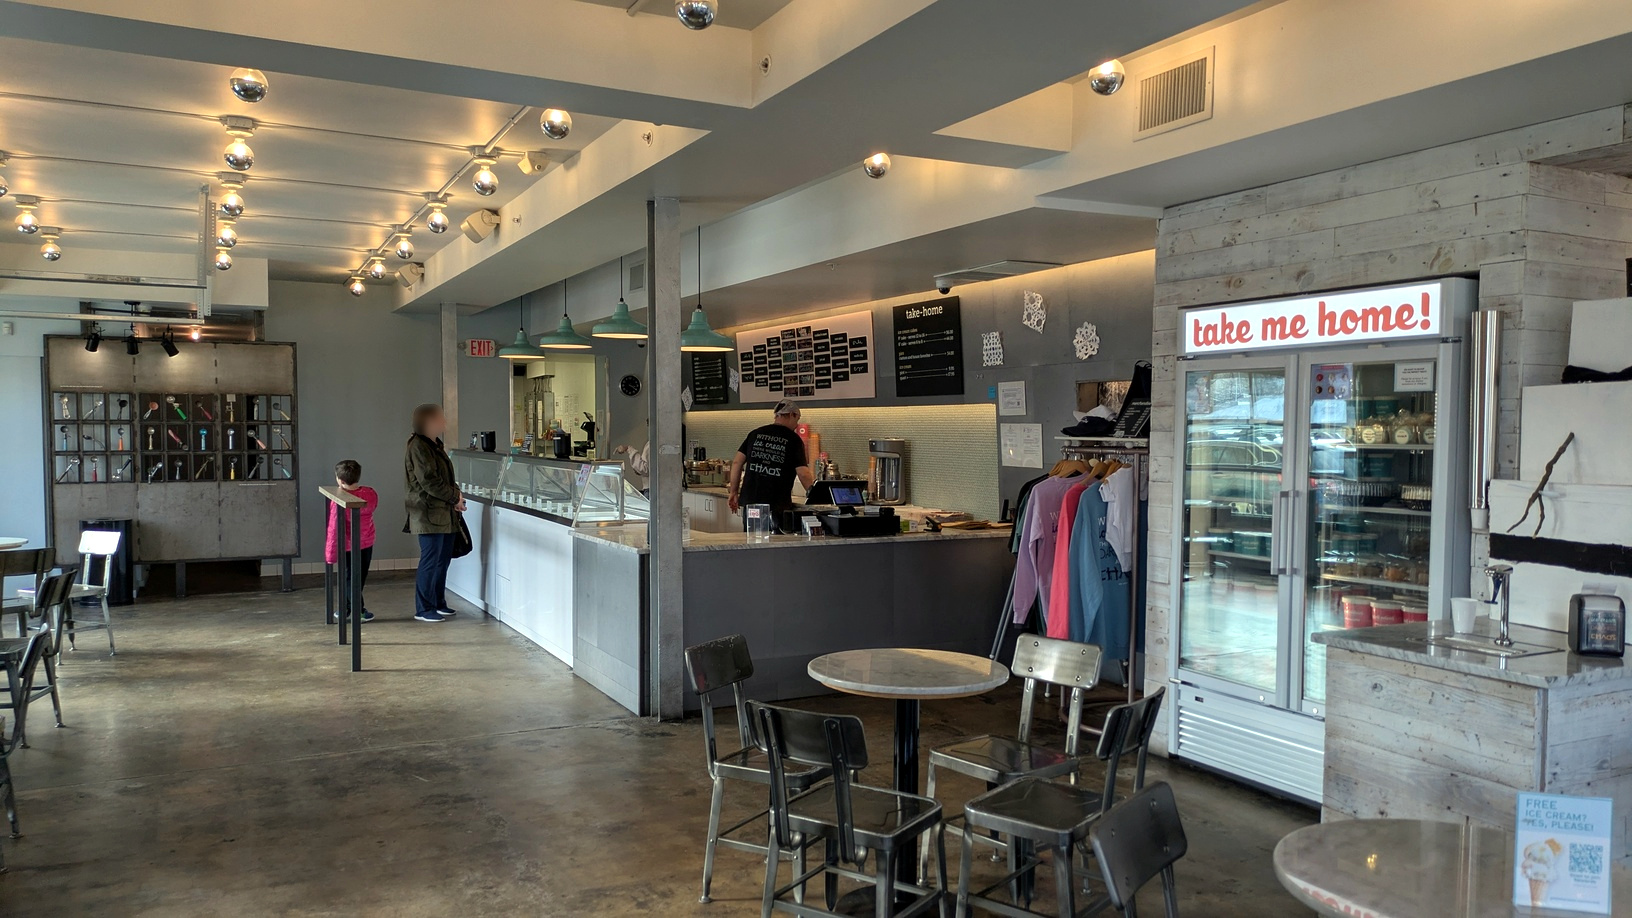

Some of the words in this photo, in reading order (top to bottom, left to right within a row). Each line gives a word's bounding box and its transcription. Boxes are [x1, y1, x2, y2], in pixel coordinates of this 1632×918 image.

[906, 305, 943, 319] take-home
[1193, 311, 1253, 347] take
[1261, 314, 1309, 341] me
[1317, 292, 1431, 337] home!
[470, 340, 491, 356] EXIT
[753, 439, 764, 447] ice
[765, 442, 787, 453] cream
[756, 433, 789, 445] WITHOUT
[750, 450, 785, 464] DARKNESS
[749, 462, 782, 477] CHAOS
[1526, 799, 1557, 810] FREE
[1525, 810, 1542, 818] ICE
[1545, 811, 1587, 822] CREAM?
[1526, 819, 1548, 830] YES,
[1551, 820, 1594, 832] PLEASE!
